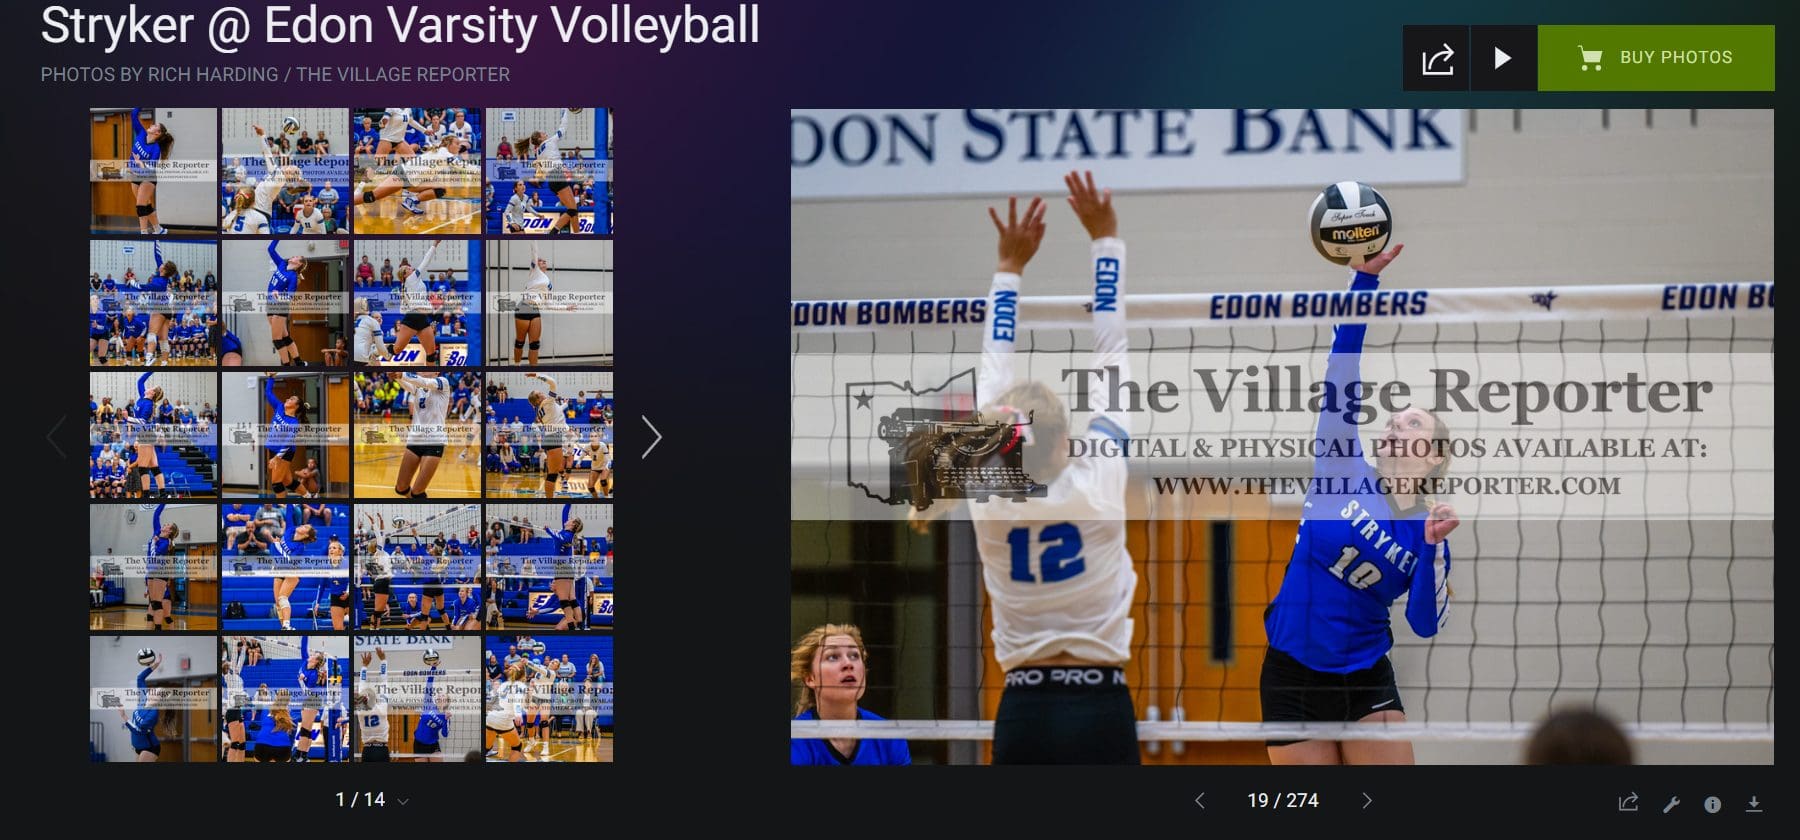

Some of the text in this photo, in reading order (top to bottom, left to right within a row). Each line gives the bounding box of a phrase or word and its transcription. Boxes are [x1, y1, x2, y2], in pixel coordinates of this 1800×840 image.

[41, 4, 759, 53] Stryker @ Edon Varsity Volleyball
[1621, 50, 1733, 64] BUY PHOTOS
[41, 66, 115, 82] PHOTOS
[120, 66, 143, 82] BY
[148, 66, 191, 82] RICH
[196, 66, 279, 82] HARDING
[296, 66, 332, 82] THE
[337, 66, 411, 82] VILLAGE
[417, 66, 511, 82] REPORTER
[963, 109, 1196, 163] STATE
[1224, 109, 1453, 155] BANK
[1332, 225, 1379, 240] molten
[1095, 257, 1119, 312] EDON
[1661, 284, 1738, 310] EDON
[792, 299, 986, 326] DON BOMBERS
[993, 290, 1017, 343] EDON
[1209, 291, 1429, 319] EDON BOMBERS
[1007, 522, 1086, 584] 12
[1328, 545, 1382, 589] 10
[1050, 668, 1104, 685] PRO
[335, 791, 344, 807] 1
[364, 791, 386, 807] 14
[1247, 792, 1269, 808] 19
[1286, 792, 1320, 808] 274
